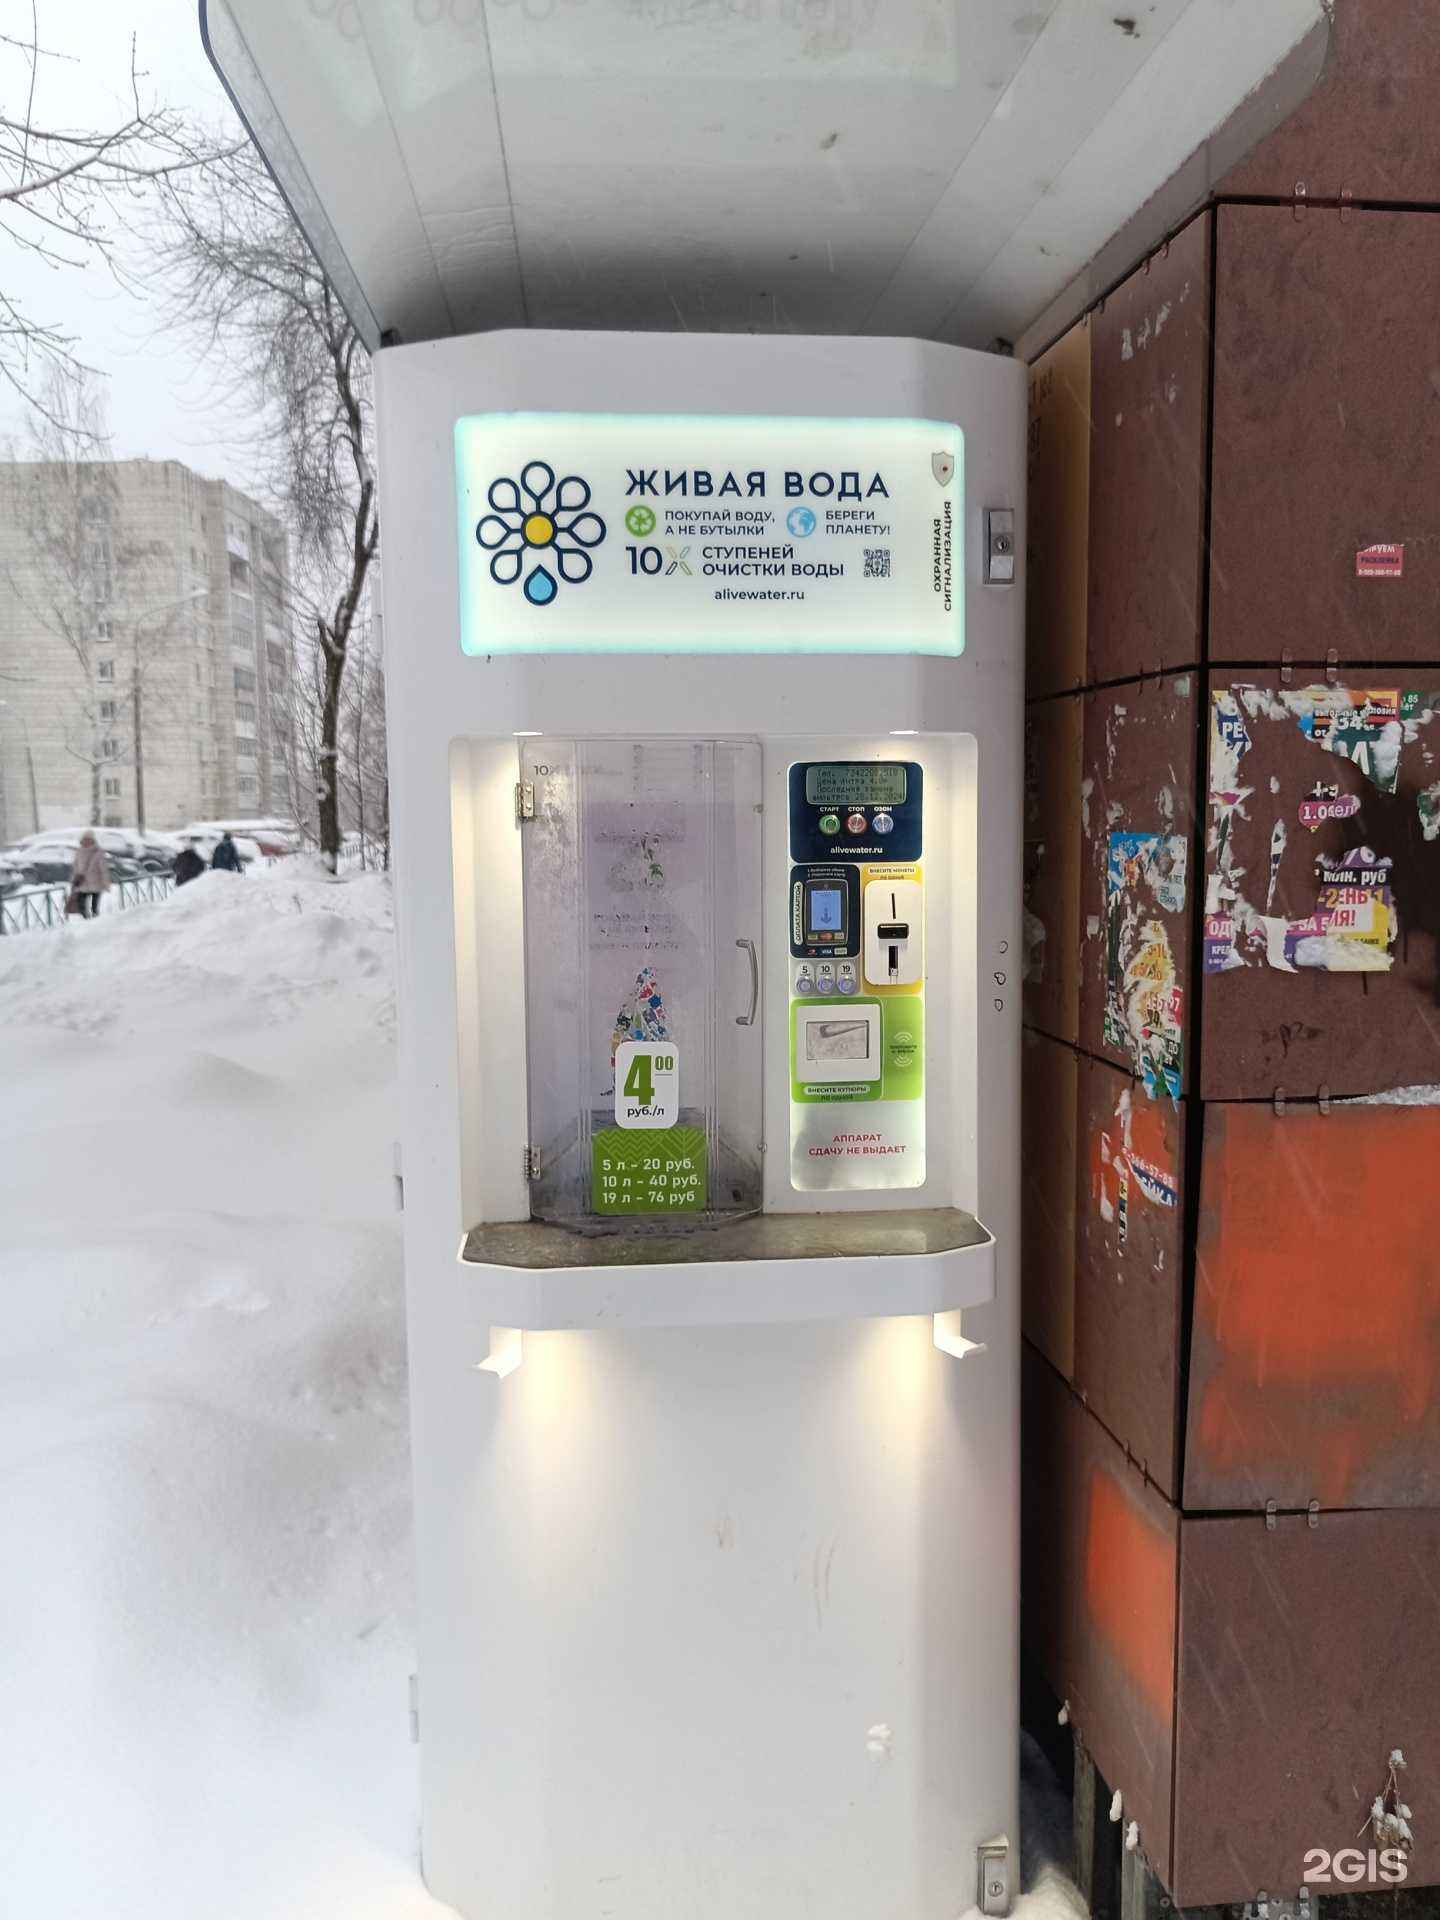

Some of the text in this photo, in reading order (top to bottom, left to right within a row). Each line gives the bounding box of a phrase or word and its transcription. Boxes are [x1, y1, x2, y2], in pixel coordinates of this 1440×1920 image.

[625, 469, 890, 502] ЖИВАЯ ВОДА
[665, 509, 775, 523] ПОКУПАЙ ВОДУ,
[826, 510, 875, 521] БЕРЕГИ
[665, 526, 764, 536] А НЕ БУТЫЛКИ
[826, 525, 890, 536] ПЛАНЕТУ!
[702, 545, 794, 560] СТУПЕНЕЙ
[943, 501, 952, 612] СИГНАЛИЗАЦИЯ
[702, 563, 844, 579] ОЧИСТКИ ВОДЫ
[714, 588, 805, 601] alivewater.ru
[830, 847, 883, 855] alivewater.ru
[820, 965, 830, 973] 10
[842, 965, 851, 973] 19
[623, 1055, 674, 1106] 4 00
[627, 1105, 665, 1118] руб./л
[833, 1134, 882, 1143] АППАРАТ
[809, 1145, 906, 1157] СДАЧУ НЕ ВЫДАЕТ
[603, 1159, 611, 1171] 5
[617, 1160, 625, 1169] л
[643, 1159, 661, 1170] 20
[666, 1158, 695, 1172] руб.
[602, 1176, 617, 1187] 10
[622, 1178, 631, 1187] л
[649, 1175, 667, 1186] 40
[672, 1174, 701, 1189] руб.
[602, 1193, 616, 1204] 19
[622, 1195, 630, 1203] л
[648, 1191, 664, 1203] 76
